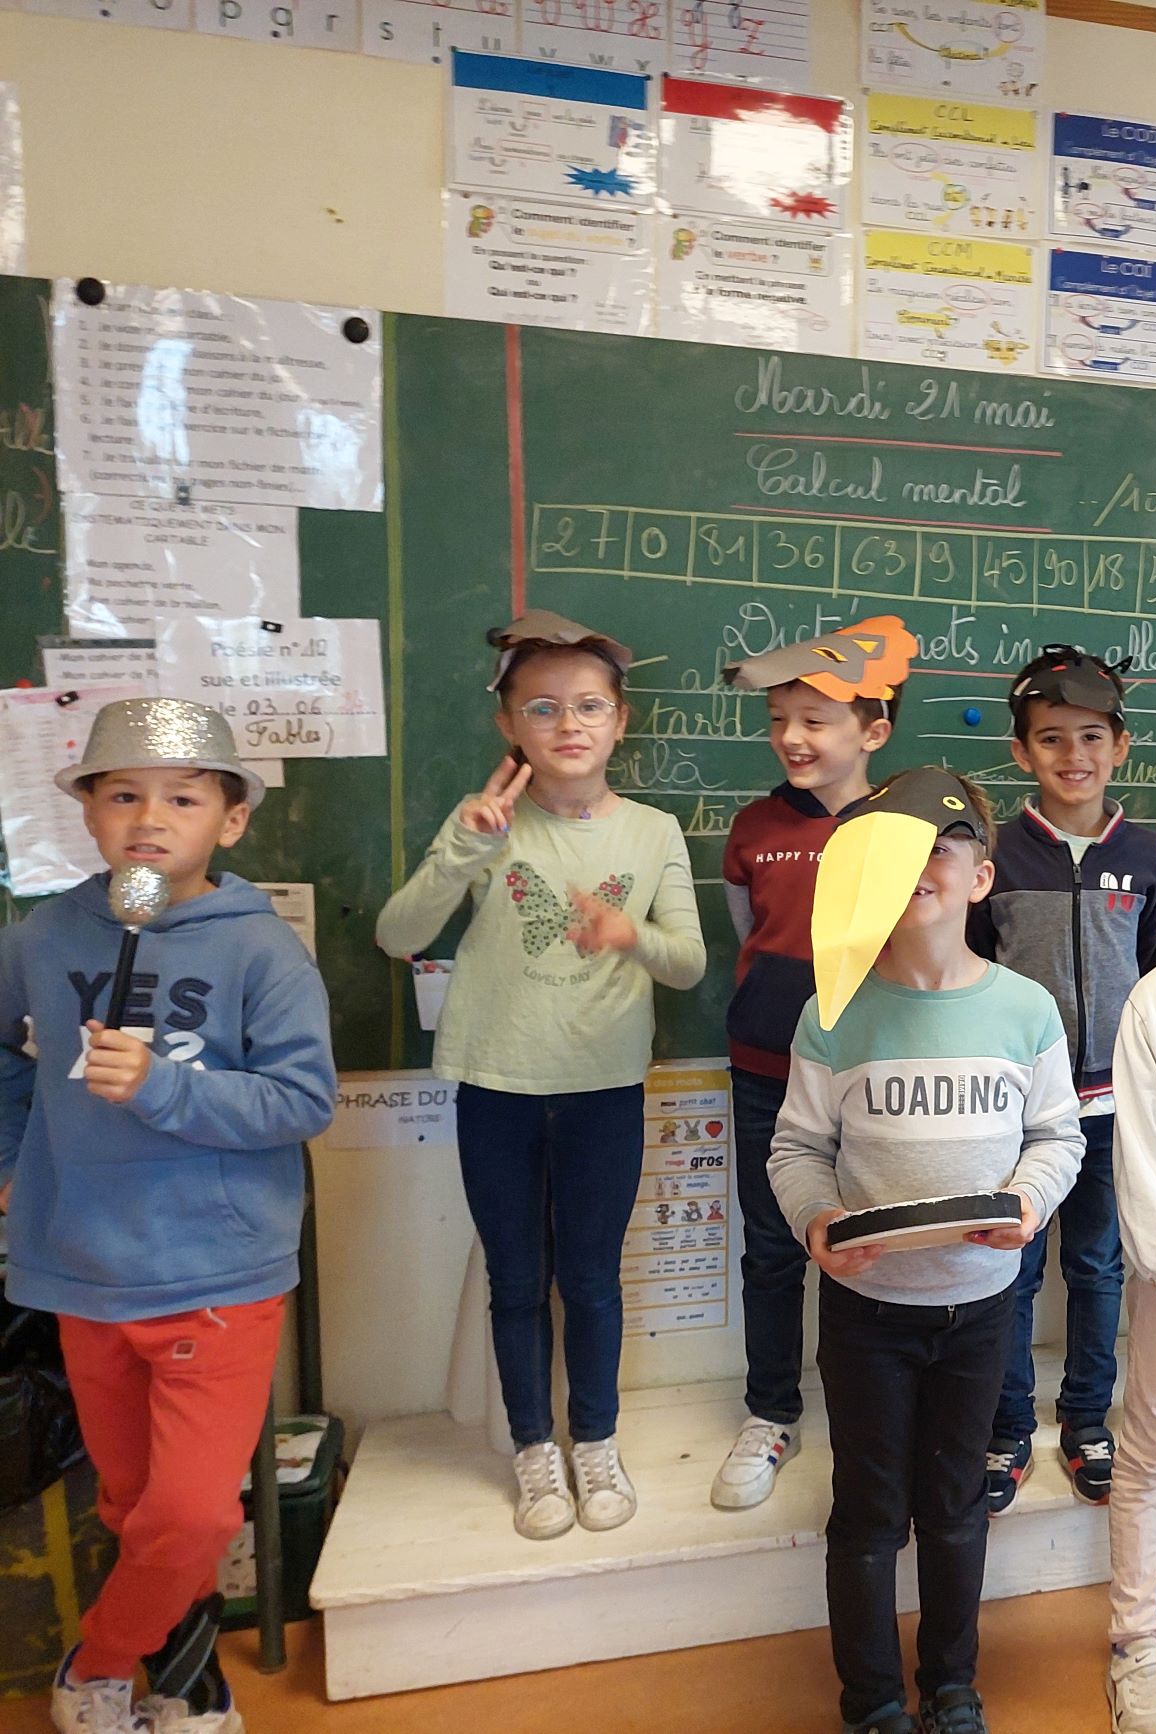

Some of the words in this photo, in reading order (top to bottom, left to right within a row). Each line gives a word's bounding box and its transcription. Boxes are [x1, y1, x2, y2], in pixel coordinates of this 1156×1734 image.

[934, 104, 974, 122] CCL
[734, 355, 889, 418] Mardi
[905, 378, 961, 421] 21
[974, 390, 1056, 428] mai
[746, 443, 888, 502] Calcul
[902, 463, 1027, 507] mental
[541, 508, 620, 559] 27
[640, 526, 668, 559] 0
[698, 523, 746, 566] 81
[768, 529, 826, 569] 36
[851, 535, 907, 577] 63
[928, 540, 955, 583] 9
[983, 541, 1028, 589] 45
[1038, 548, 1078, 589] 90
[1088, 553, 1125, 592] 18
[722, 598, 861, 657] Dict
[200, 674, 235, 687] sue
[240, 672, 258, 687] et
[604, 740, 728, 790] oilà
[755, 851, 801, 863] HAPPY
[522, 965, 566, 987] LOVELY
[569, 970, 591, 985] DAY
[68, 970, 213, 1031] YES
[418, 1090, 448, 1107] DU
[865, 1074, 1009, 1116] LOADING
[690, 1155, 724, 1170] gros
